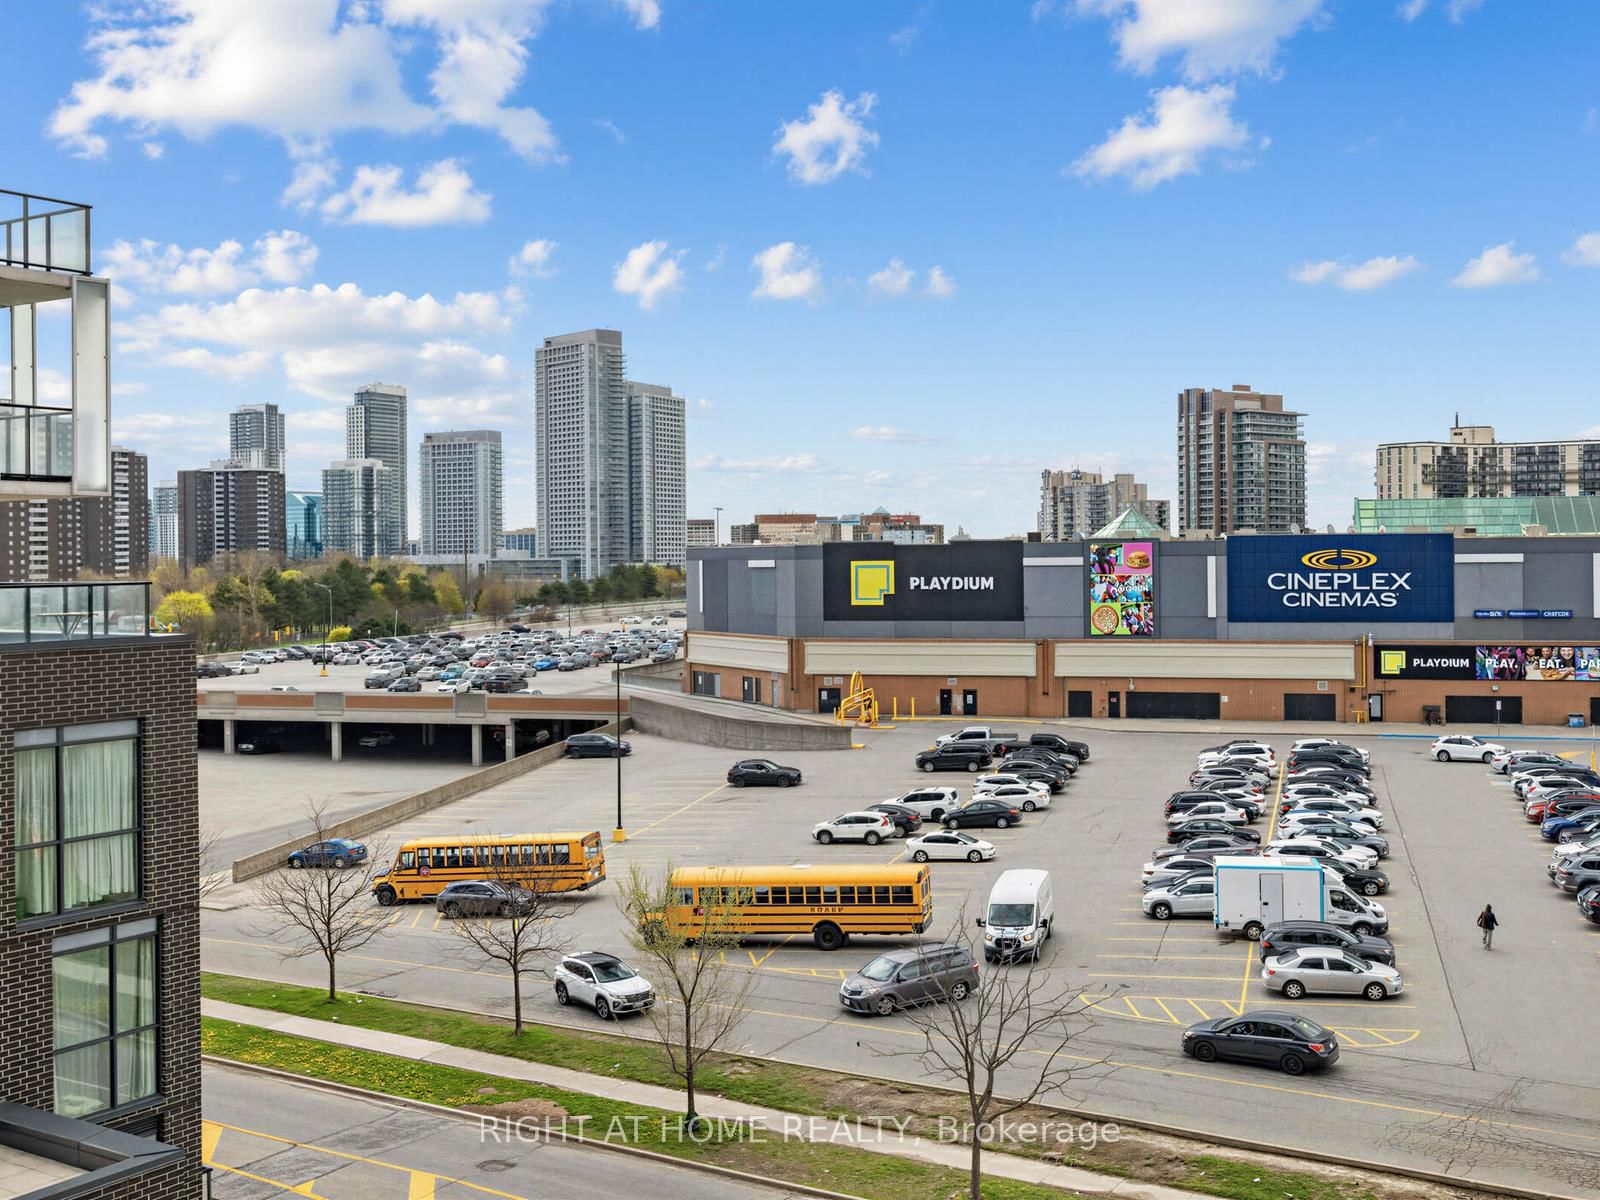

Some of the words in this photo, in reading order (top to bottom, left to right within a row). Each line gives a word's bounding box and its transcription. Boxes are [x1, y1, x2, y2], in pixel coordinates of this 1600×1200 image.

[909, 576, 994, 590] PLAYDIUM
[1267, 572, 1412, 591] CINEPLEX
[1282, 592, 1398, 608] CINEMAS
[1412, 658, 1470, 668] PLAYDIUM
[1485, 658, 1519, 669] PLAY.
[1538, 658, 1564, 669] EAT.
